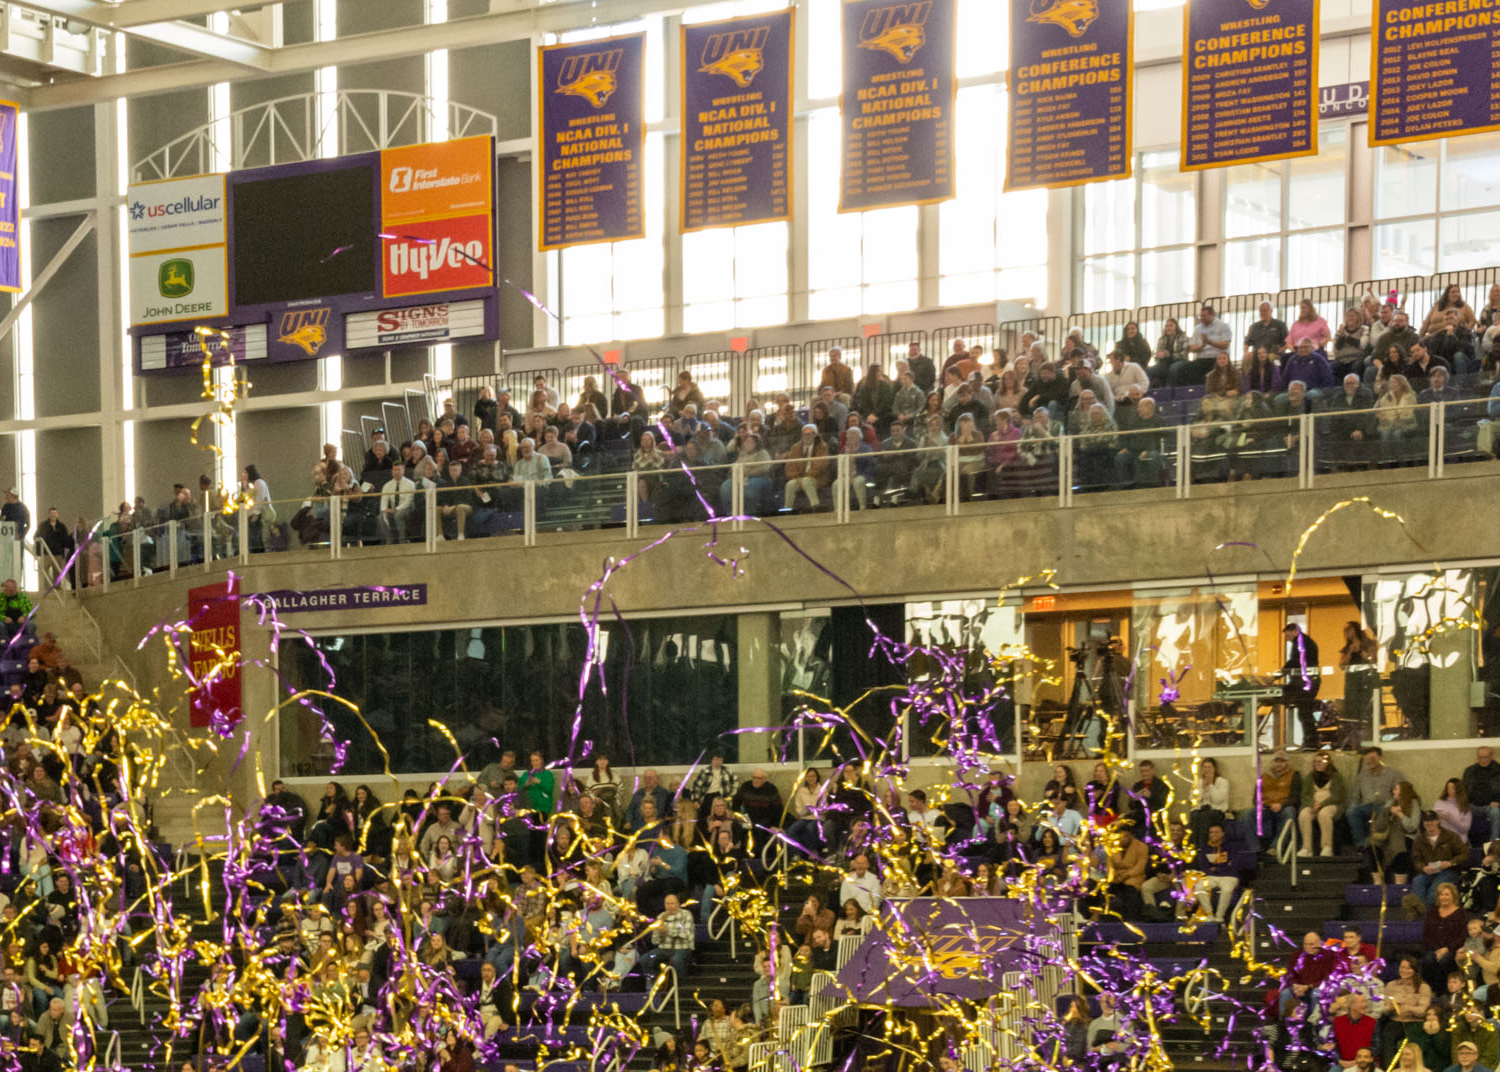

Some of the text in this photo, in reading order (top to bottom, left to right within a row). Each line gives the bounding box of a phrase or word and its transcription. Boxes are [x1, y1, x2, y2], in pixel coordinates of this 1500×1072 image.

[860, 0, 932, 41] UNI
[1220, 15, 1281, 31] WRESTLING
[701, 25, 771, 66] UNI
[1194, 24, 1306, 52] CONFERENCE
[1041, 42, 1098, 58] WRESTLING
[1194, 40, 1306, 69] CHAMPIONS
[557, 48, 623, 87] UNI
[1017, 52, 1121, 79] CONFERENCE
[1423, 58, 1451, 68] COLON
[1017, 68, 1120, 95] CHAMPIONS
[1406, 72, 1430, 82] DAVID
[1406, 82, 1426, 91] JOEY
[857, 84, 897, 100] NCAA
[901, 80, 929, 94] DIV.
[1406, 91, 1438, 102] COOPER
[1440, 86, 1469, 97] MOORE
[698, 107, 737, 123] NCAA
[740, 103, 767, 117] DIV.
[861, 93, 932, 114] NATIONAL
[1406, 103, 1425, 112] JOEY
[703, 117, 770, 136] NATIONAL
[852, 106, 941, 129] CHAMPIONS
[1405, 123, 1431, 133] DYLAN
[1432, 118, 1463, 128] PETERS
[1406, 114, 1420, 123] JOE
[1421, 110, 1450, 120] COLON
[556, 127, 592, 143] NCAA
[595, 124, 620, 137] DIV.
[694, 128, 779, 152] CHAMPIONS
[561, 137, 623, 156] NATIONAL
[552, 149, 632, 171] CHAMPIONS
[413, 173, 481, 191] Interstate Bank
[414, 168, 438, 179] First
[147, 195, 220, 218] uscellular
[142, 301, 212, 318] JOHN DEERE
[377, 304, 449, 332] SIGNS
[280, 308, 331, 337] UNI
[400, 317, 449, 330] BY TOMORROW
[263, 588, 421, 610] GALLAGHER TERRACE
